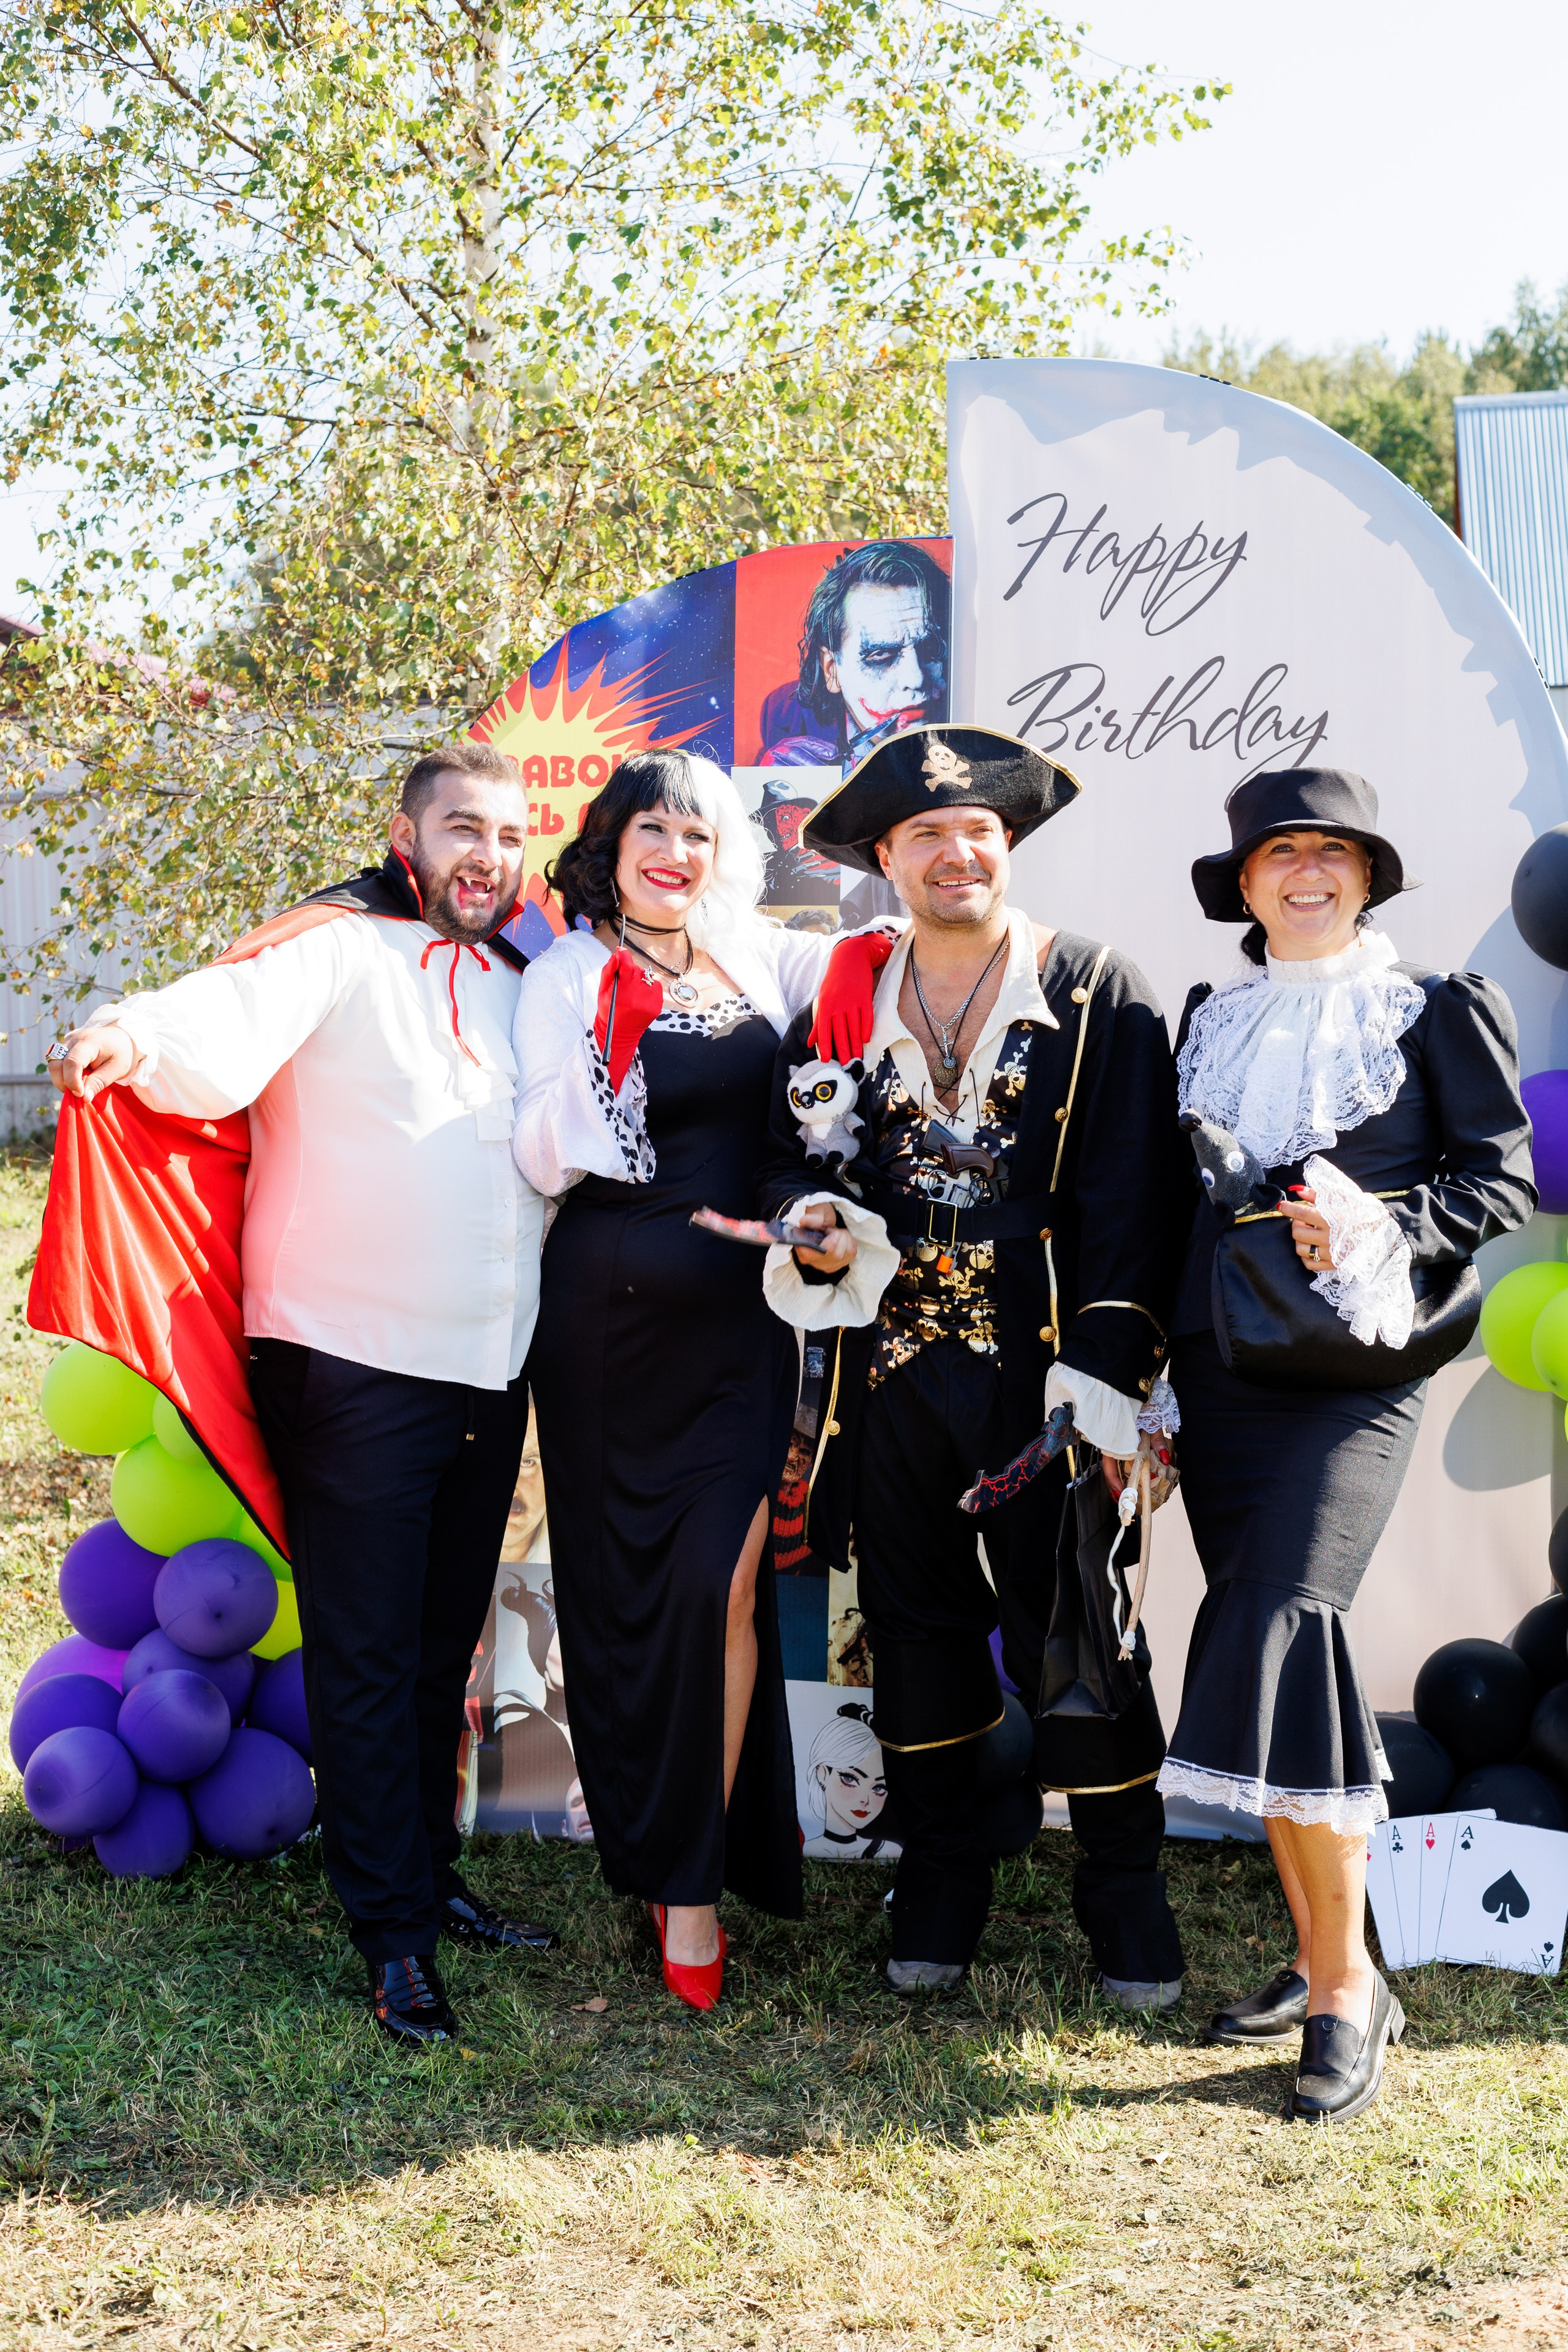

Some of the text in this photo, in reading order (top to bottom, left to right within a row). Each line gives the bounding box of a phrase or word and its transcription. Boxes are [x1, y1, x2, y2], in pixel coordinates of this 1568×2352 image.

[1003, 492, 1248, 636] Happy
[1007, 655, 1328, 812] Birthday
[505, 754, 622, 788] АВО
[1392, 1825, 1402, 1840] A
[1425, 1822, 1436, 1838] A
[1460, 1825, 1474, 1839] A
